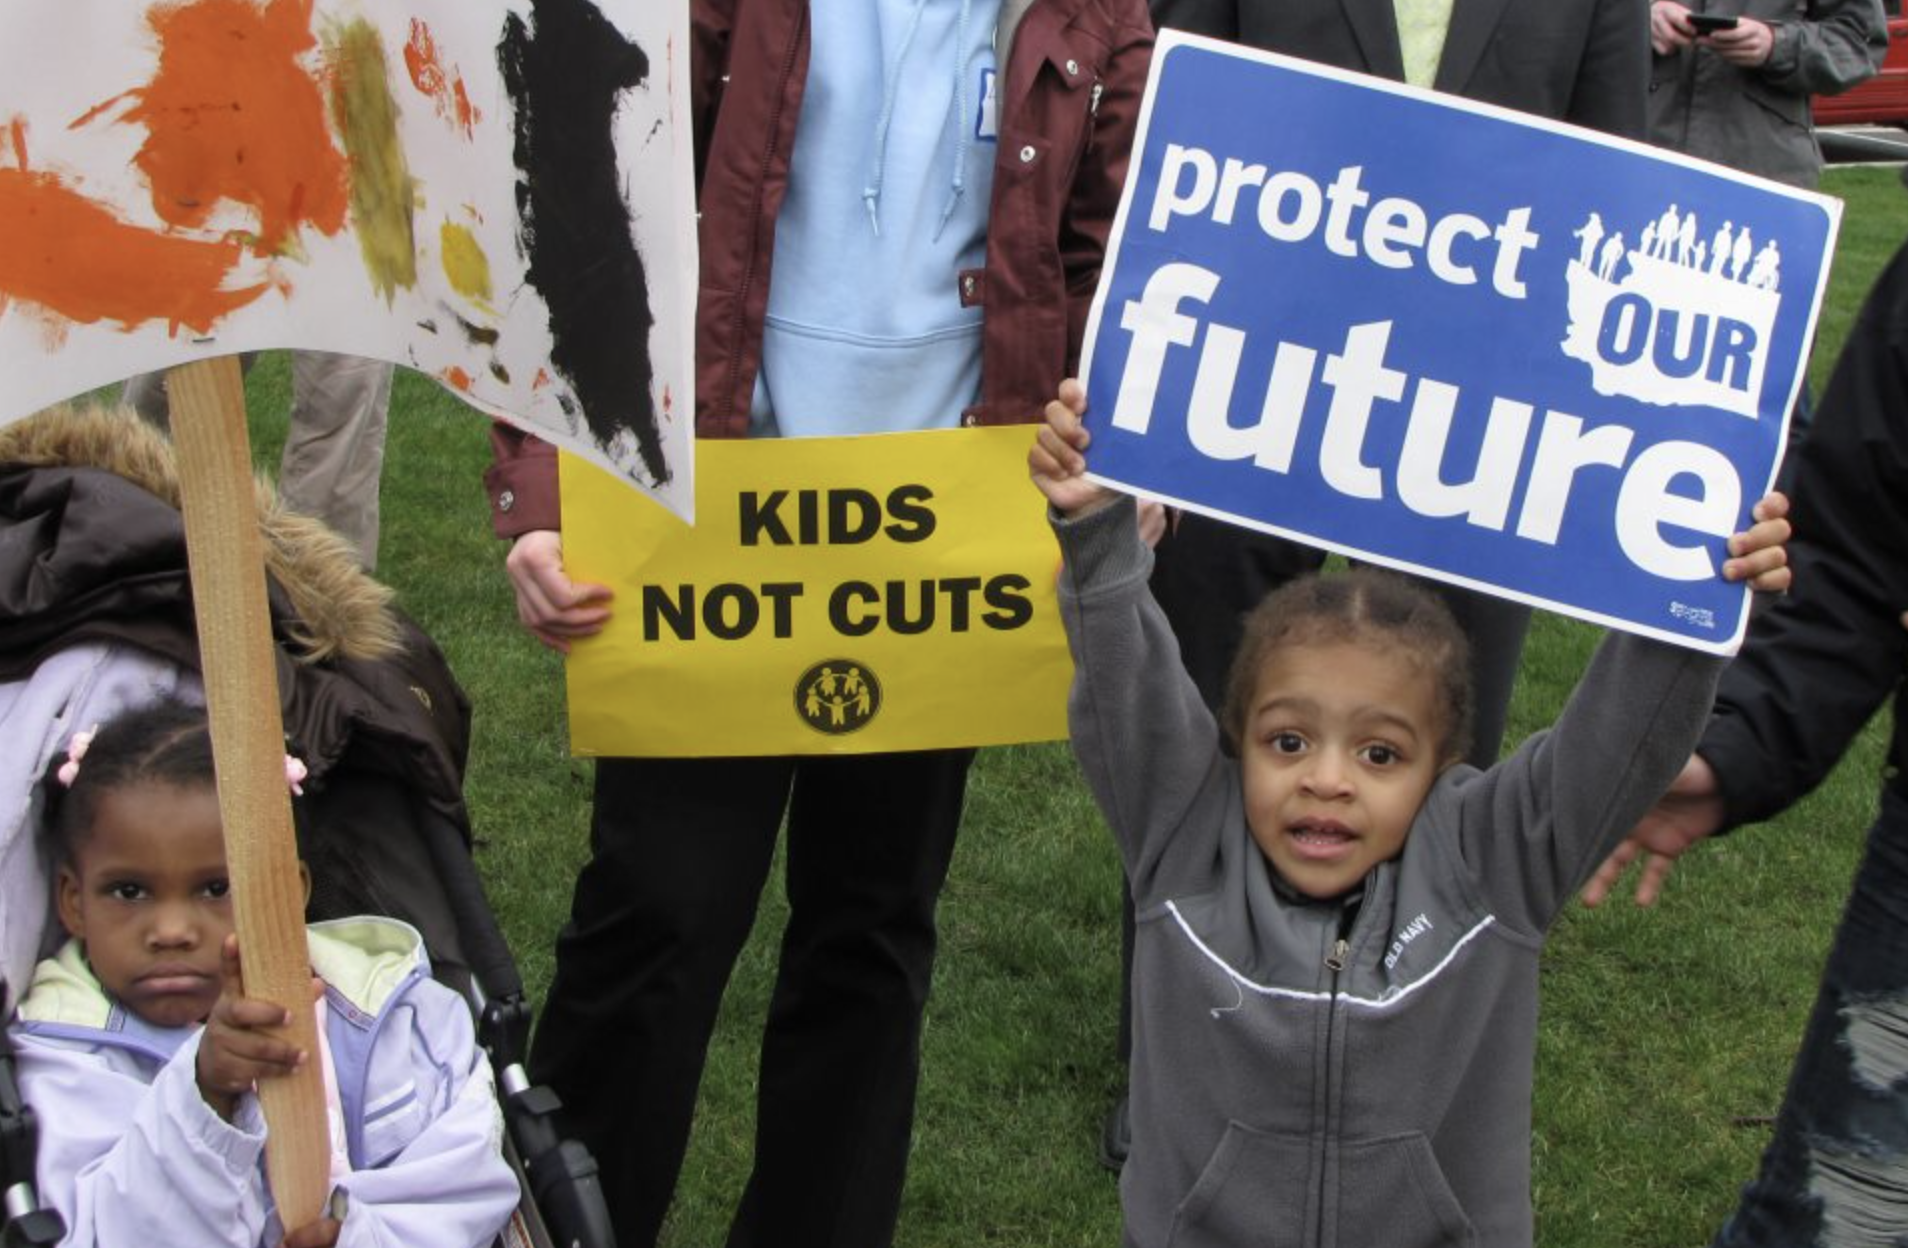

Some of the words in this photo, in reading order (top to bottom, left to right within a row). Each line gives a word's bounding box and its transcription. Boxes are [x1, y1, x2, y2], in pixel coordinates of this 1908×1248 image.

[1148, 142, 1539, 299] protect
[1595, 291, 1758, 393] OUR
[1111, 262, 1743, 582] future
[738, 484, 937, 547] KIDS
[641, 582, 804, 642] NOT
[828, 573, 1034, 637] CUTS
[1384, 941, 1404, 969] OLD
[1398, 912, 1434, 944] NAVY
